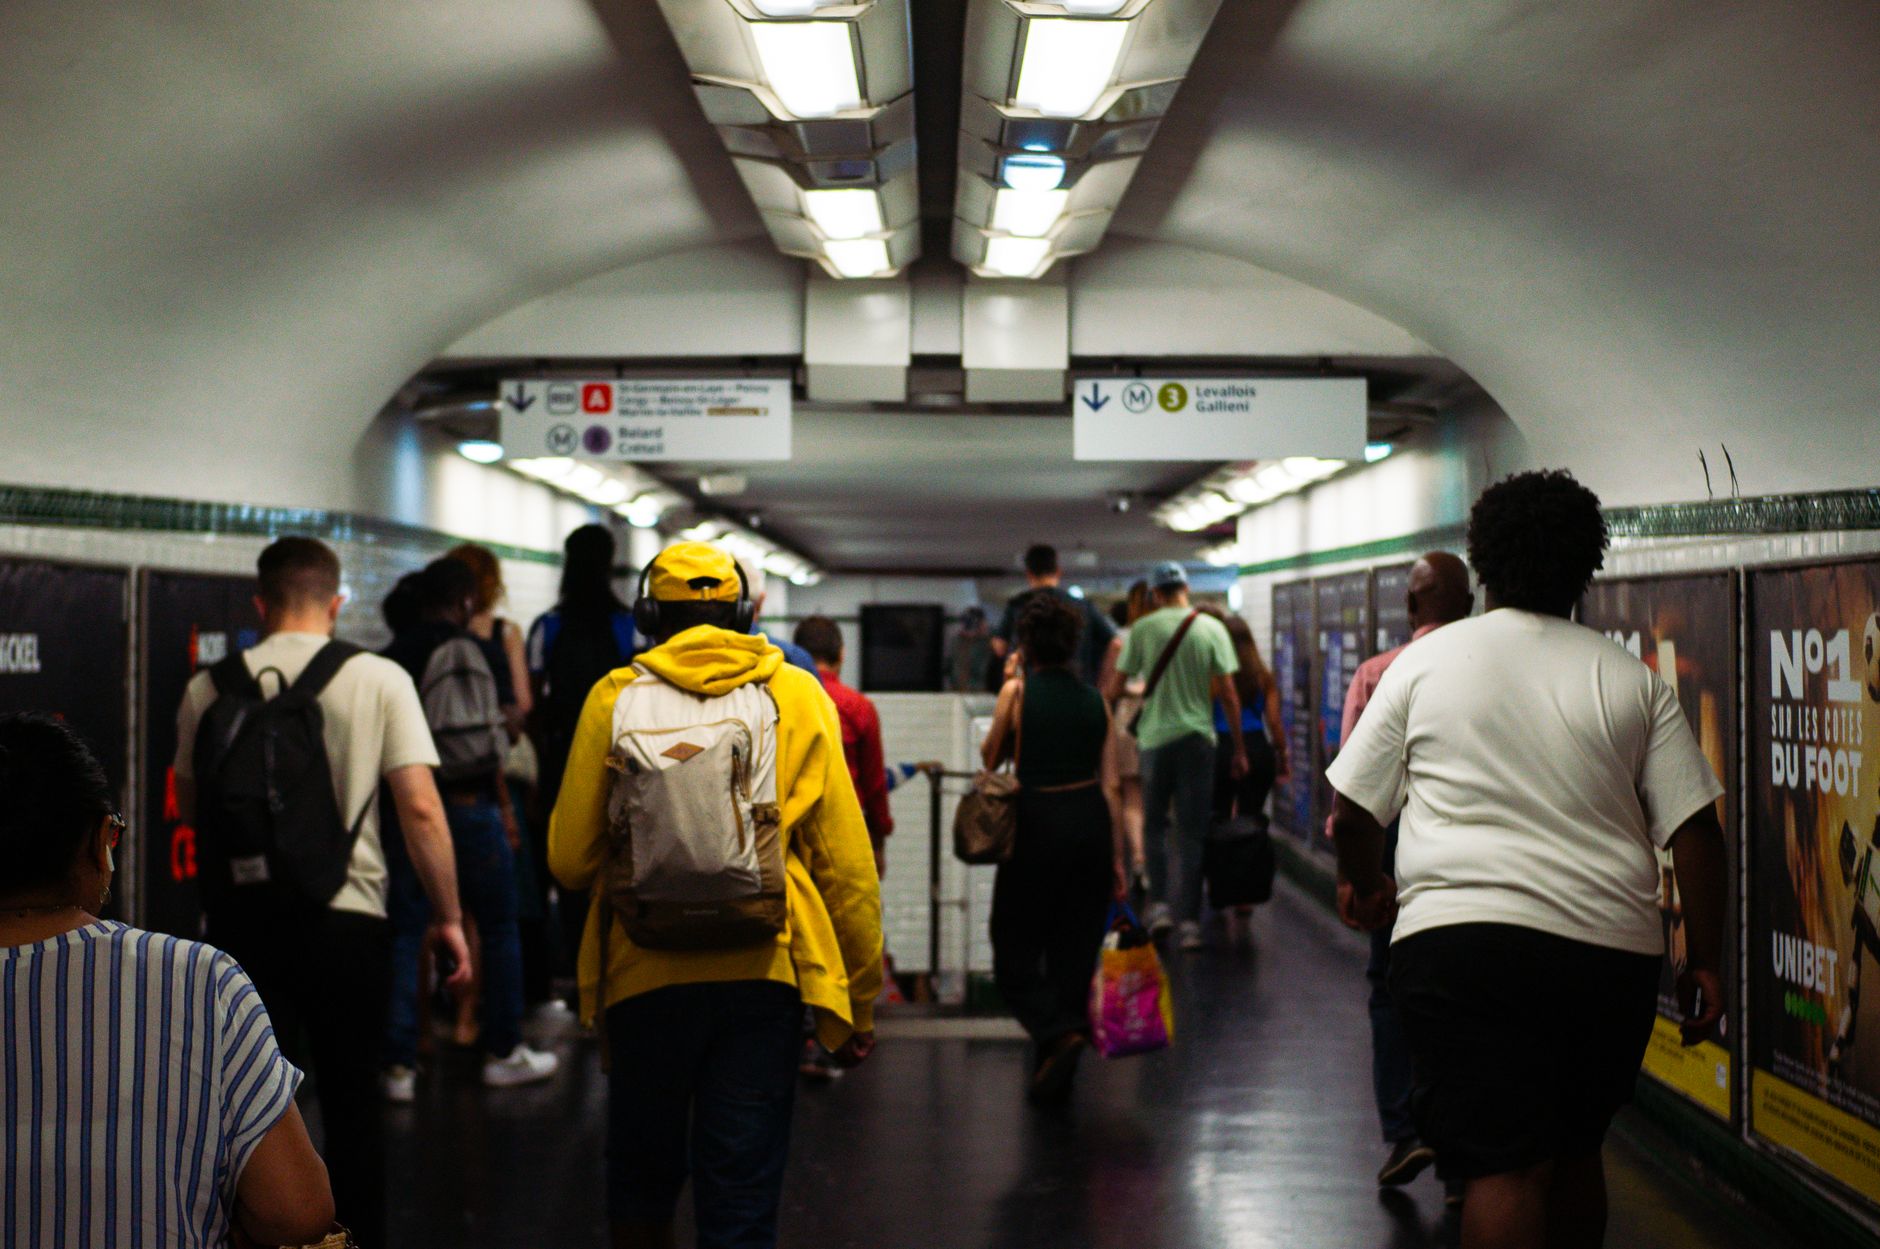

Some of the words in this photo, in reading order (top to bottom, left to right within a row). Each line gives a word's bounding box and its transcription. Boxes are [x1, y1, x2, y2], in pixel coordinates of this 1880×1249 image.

[587, 388, 606, 409] A
[1165, 387, 1180, 409] 3
[1195, 385, 1256, 398] Levallois
[1195, 400, 1250, 413] Gallieni
[1771, 704, 1792, 739] SUR
[1798, 705, 1819, 741] LES
[1824, 706, 1863, 746] COTES
[1771, 741, 1799, 790] DU
[1805, 744, 1863, 799] FOOT
[1772, 928, 1838, 997] UNIBET
